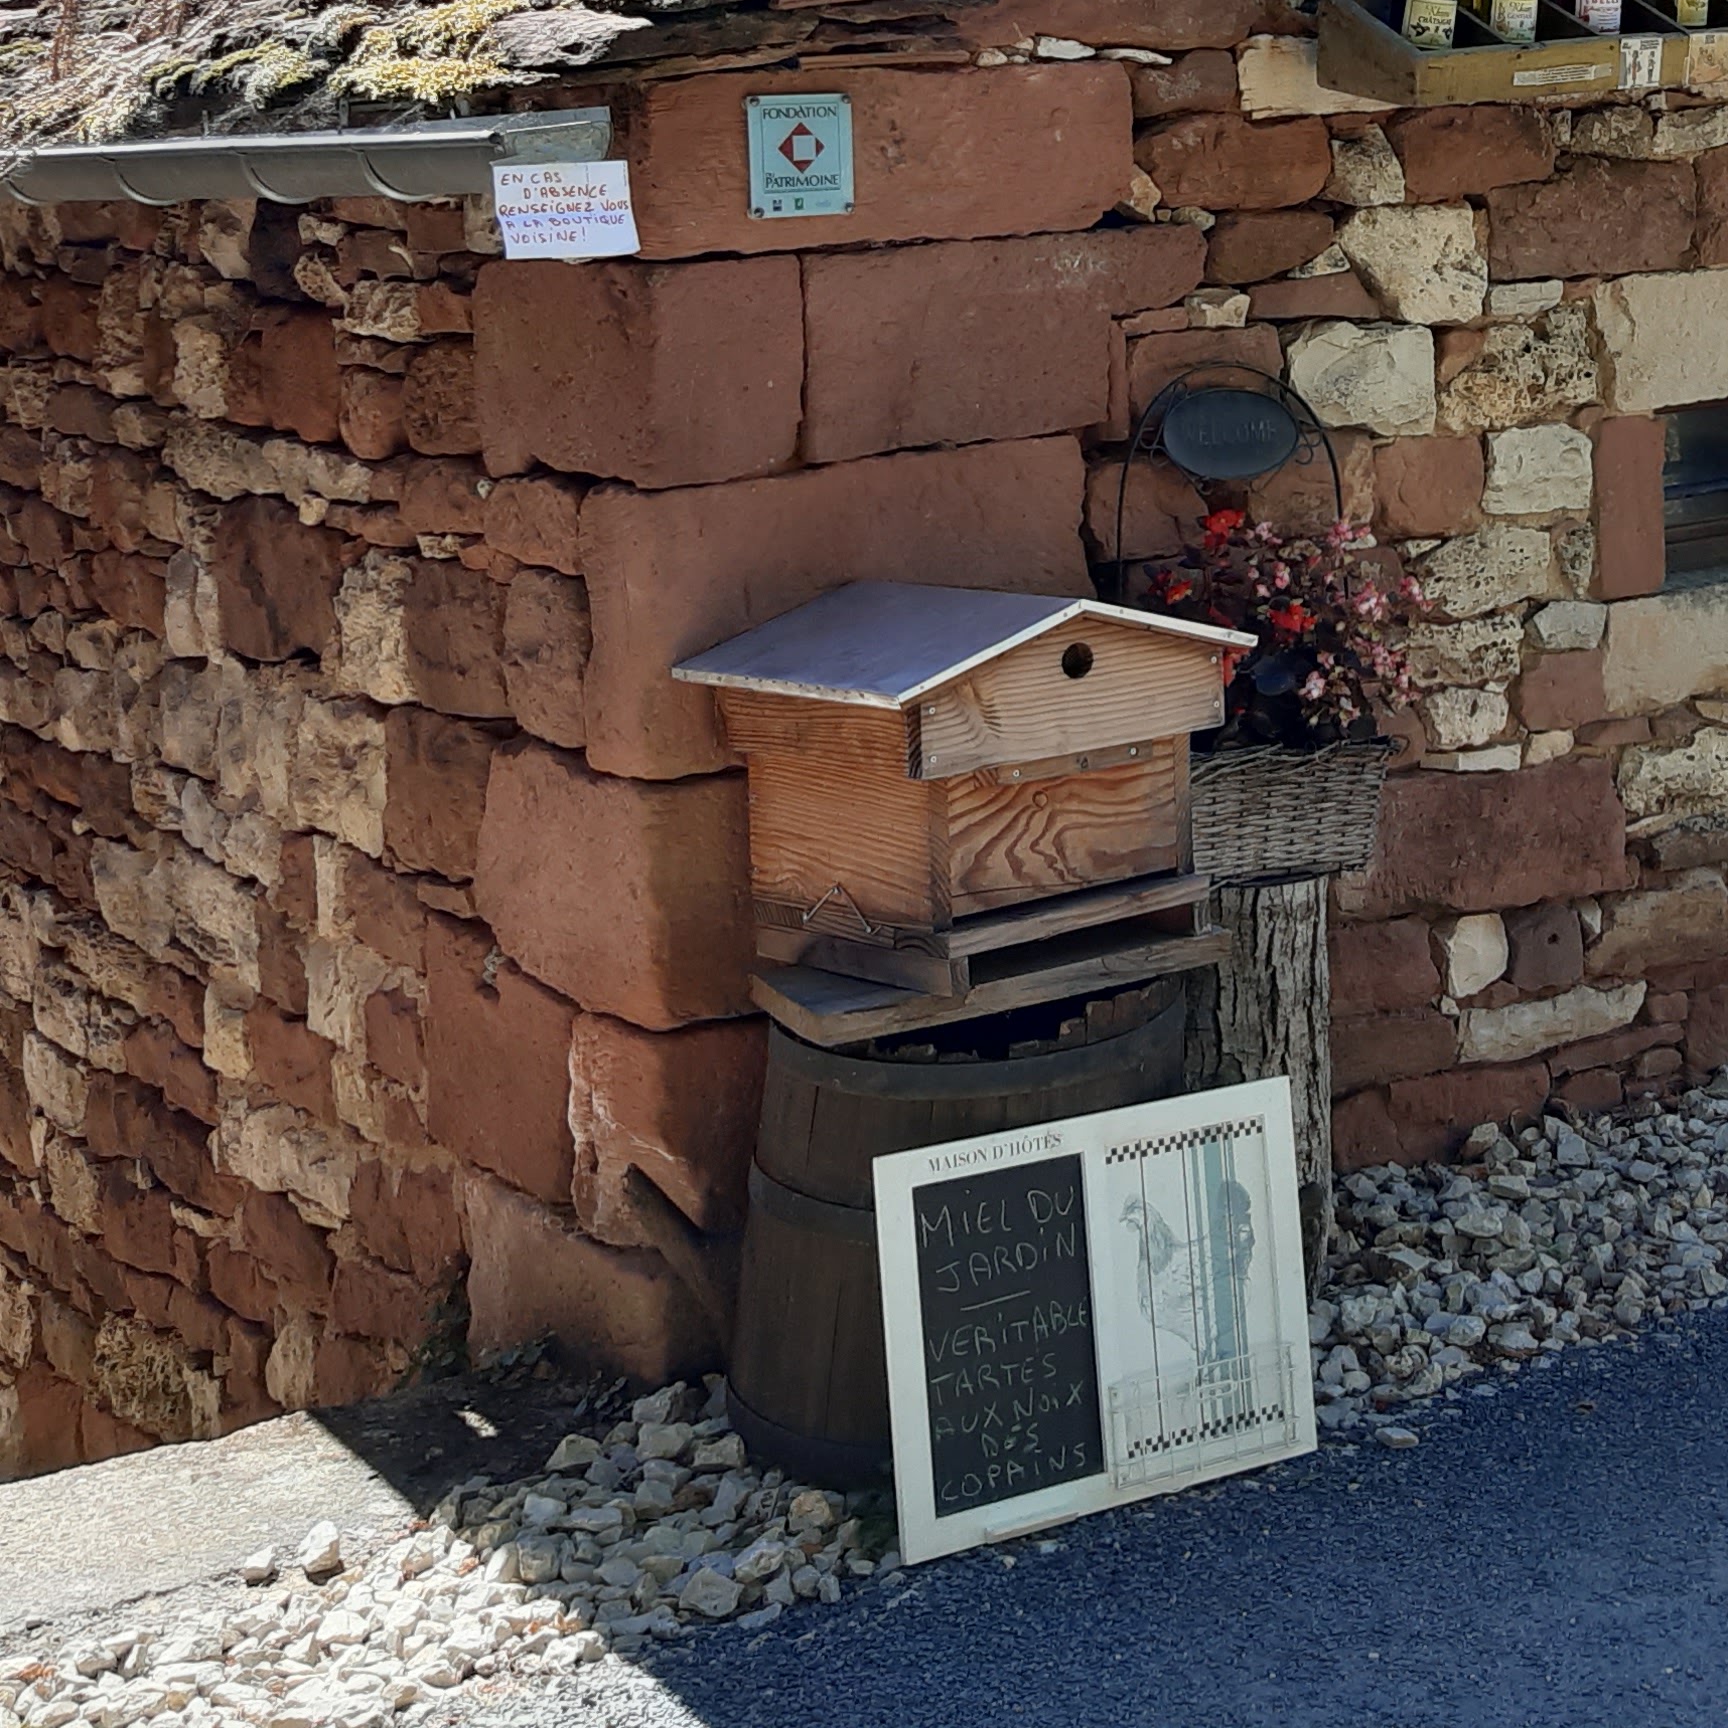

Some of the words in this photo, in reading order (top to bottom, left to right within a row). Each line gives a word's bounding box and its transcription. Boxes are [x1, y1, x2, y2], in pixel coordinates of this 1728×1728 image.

[763, 106, 838, 120] FONDATION
[501, 173, 523, 186] EN
[531, 171, 562, 184] CAS
[765, 175, 840, 188] PATRIMOINE
[523, 184, 607, 200] D'ABSENCE
[600, 199, 629, 211] VOUS
[524, 218, 543, 228] LA
[929, 1146, 988, 1173] MAISON
[1026, 1185, 1074, 1223] DU
[930, 1353, 1057, 1406] TARTES
[935, 1401, 1003, 1441] AUX
[981, 1423, 1040, 1458] DES
